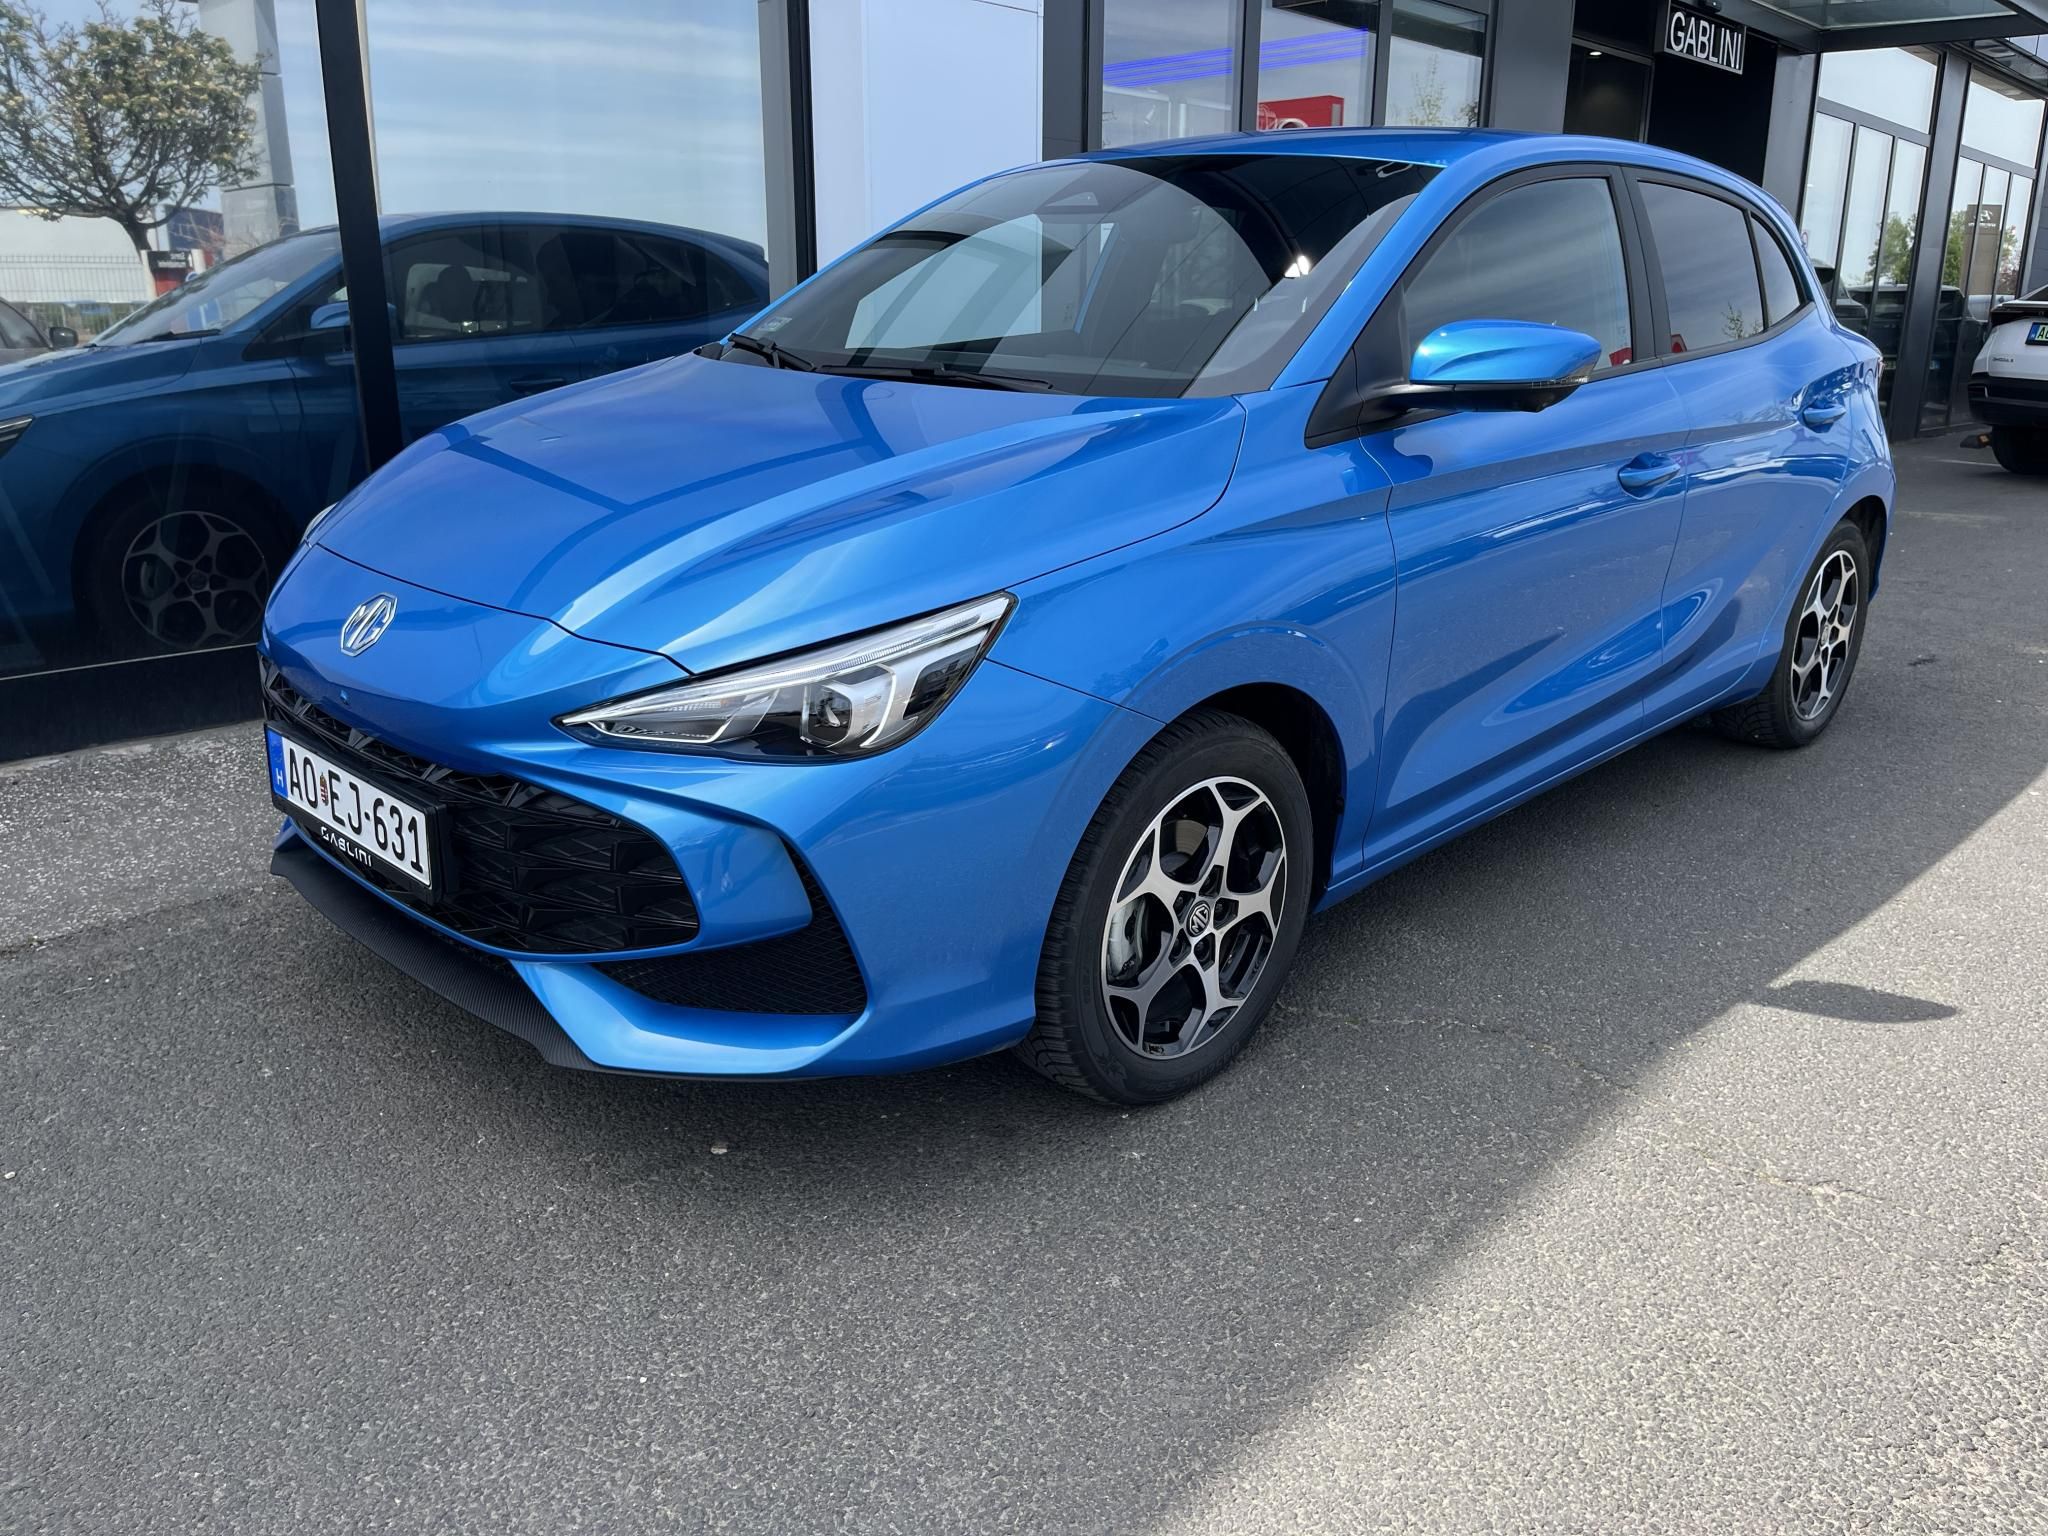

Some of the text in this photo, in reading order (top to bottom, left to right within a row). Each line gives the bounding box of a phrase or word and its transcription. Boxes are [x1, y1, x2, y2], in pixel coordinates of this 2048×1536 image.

[1670, 11, 1742, 70] GABLINI
[343, 595, 395, 653] MG
[275, 767, 284, 788] H
[320, 826, 373, 867] GABLINI
[1190, 905, 1209, 934] MG
